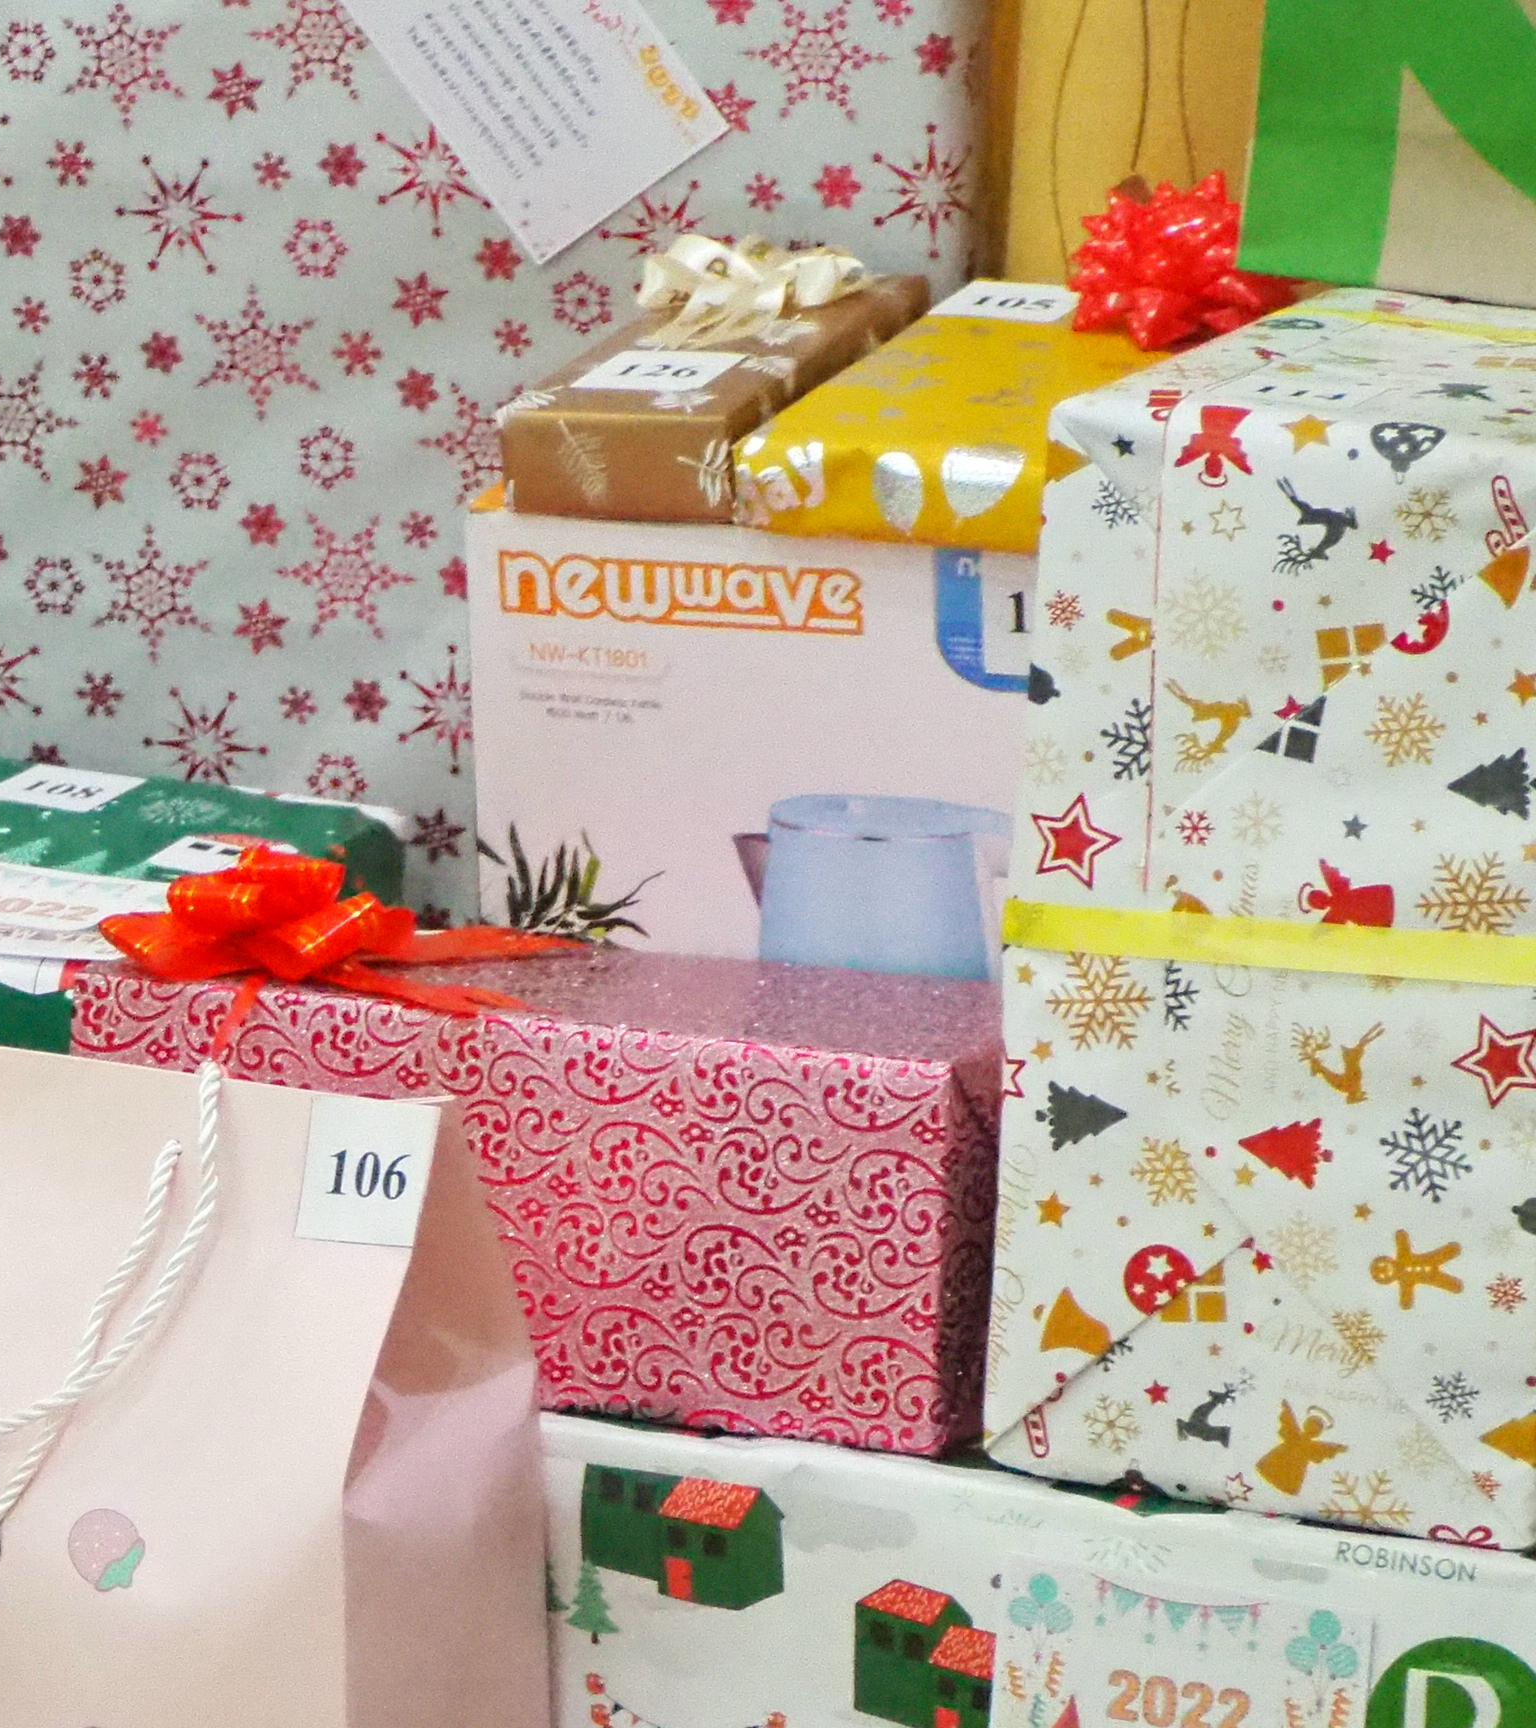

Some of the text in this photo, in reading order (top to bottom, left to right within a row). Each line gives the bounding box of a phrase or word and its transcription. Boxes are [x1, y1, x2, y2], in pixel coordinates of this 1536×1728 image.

[971, 294, 1056, 312] 105
[614, 361, 699, 380] 126
[499, 550, 864, 634] newwave
[24, 775, 103, 799] 108
[325, 1149, 407, 1200] 106
[1335, 1540, 1479, 1583] ROBINSON
